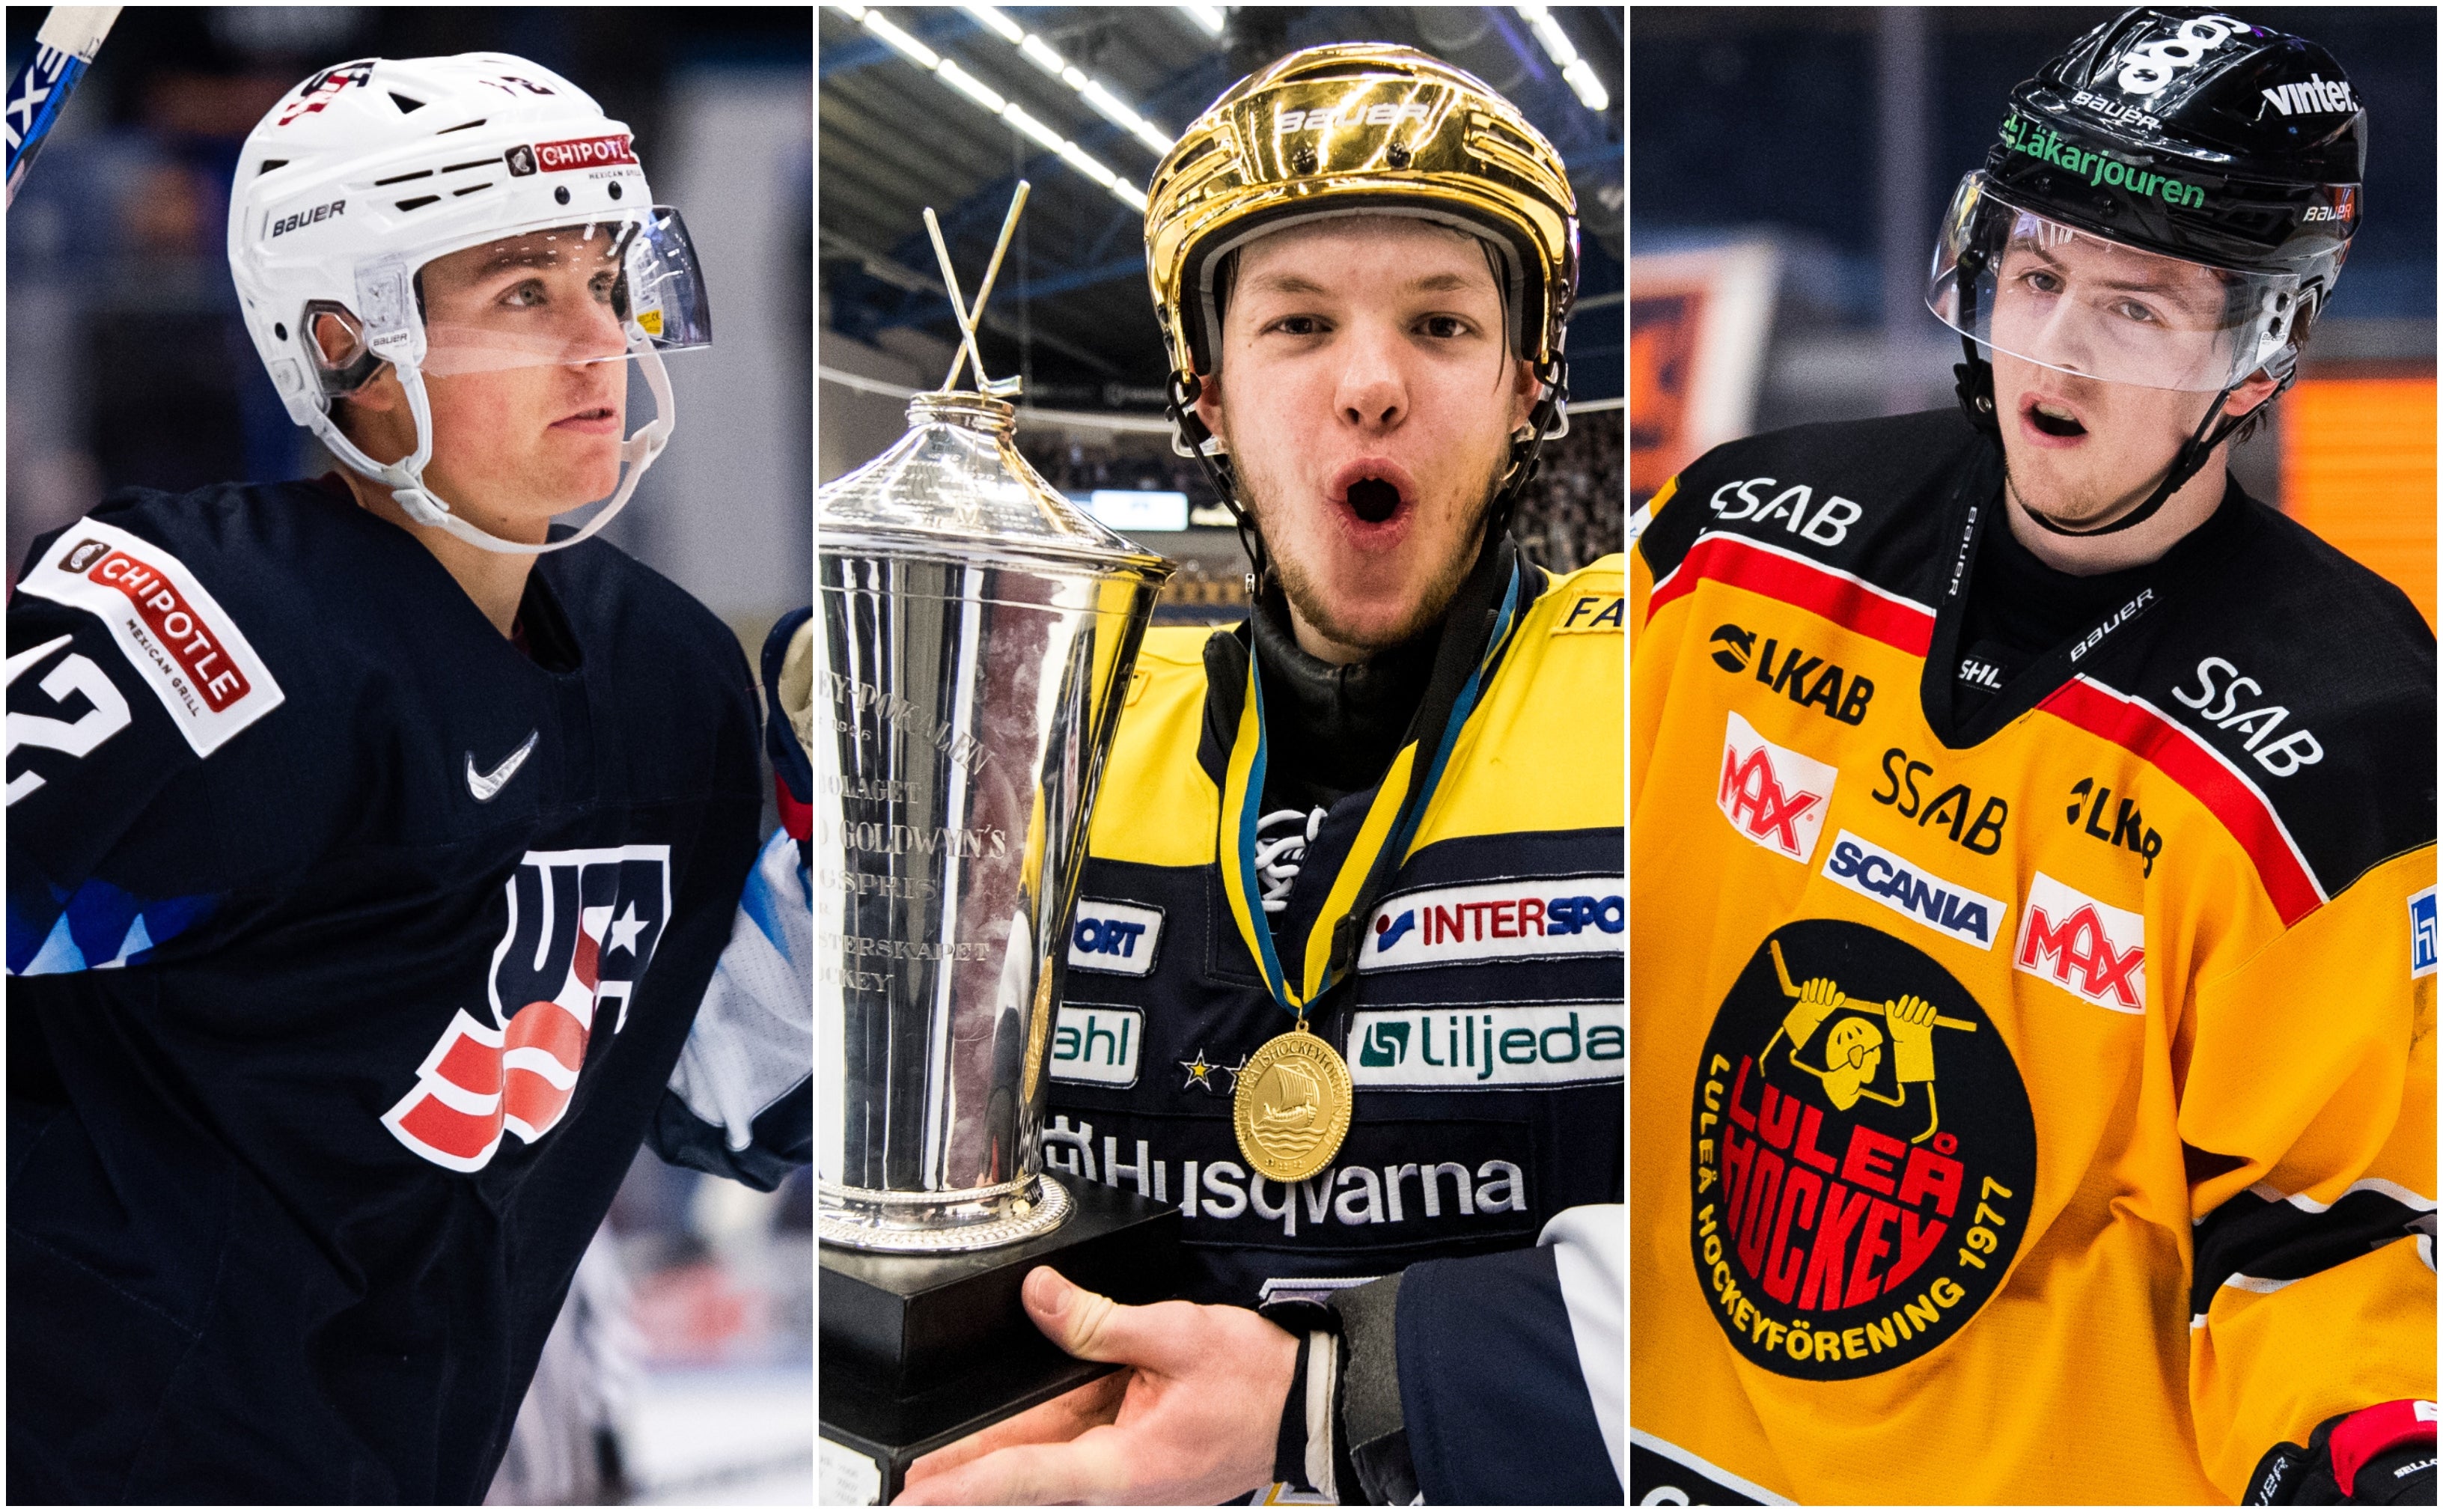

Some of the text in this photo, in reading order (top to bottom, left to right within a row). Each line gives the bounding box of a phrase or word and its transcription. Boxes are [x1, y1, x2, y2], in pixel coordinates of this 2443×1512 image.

[1278, 103, 1430, 135] BAUER
[2070, 89, 2162, 131] BAUER
[588, 171, 623, 180] MEXICAN
[2015, 123, 2205, 209] Läkarjouren
[272, 199, 347, 238] BAUER
[2302, 204, 2352, 222] BAUER
[373, 332, 407, 347] BAUER
[1948, 505, 1978, 597] BAUER
[102, 557, 241, 702] CHIPOTLE
[1564, 597, 1624, 628] FA
[2070, 587, 2155, 663] BAUER
[125, 618, 201, 718] MEXICAN GRILL
[1755, 636, 1875, 727] LKAB
[2171, 656, 2324, 778] SSAB
[840, 819, 1007, 859] GOLDWYN'S
[1720, 743, 1822, 857] MAX
[1870, 747, 2009, 856] SSAB
[1829, 840, 1989, 944] SCANIA
[2019, 902, 2147, 1010] MAX
[1729, 1054, 1964, 1219] LULEÅ
[1103, 1135, 1528, 1237] Husqvarna
[1698, 1052, 2013, 1362] LULEÅ HOCKEYFÖRENING 1977
[1723, 1123, 1949, 1312] HOCKEY
